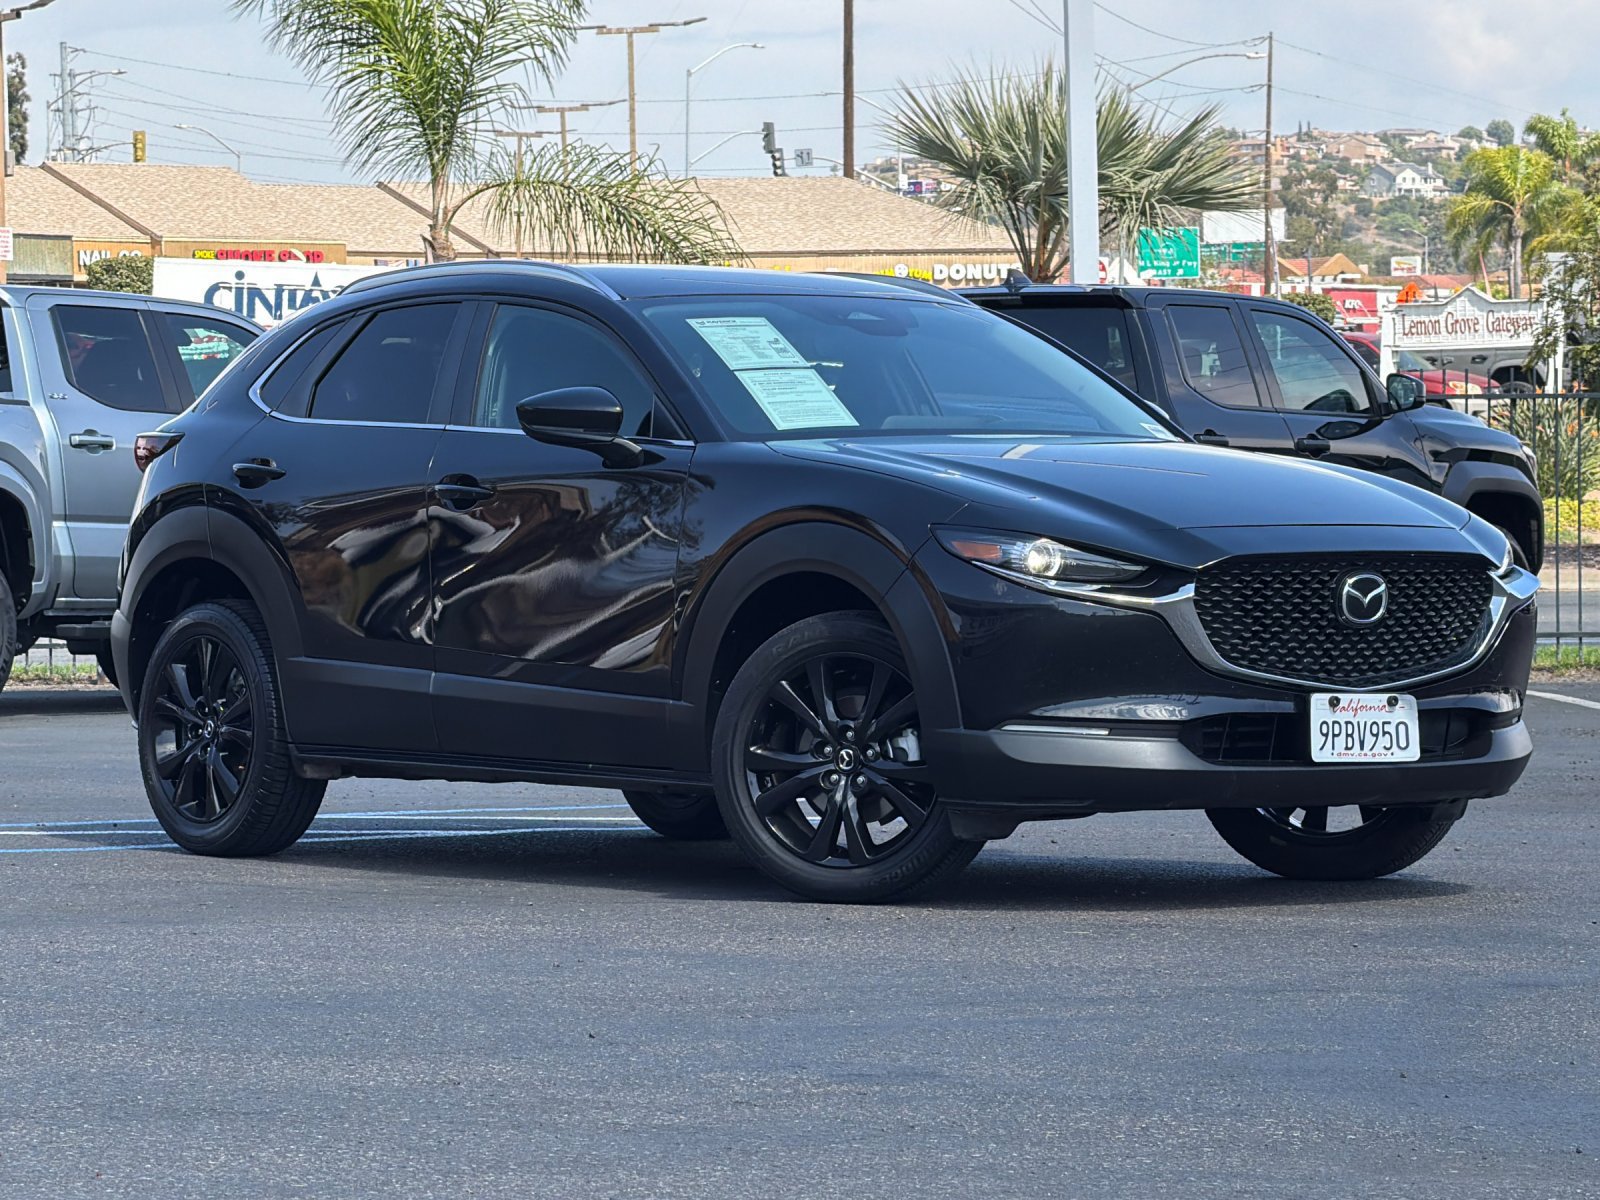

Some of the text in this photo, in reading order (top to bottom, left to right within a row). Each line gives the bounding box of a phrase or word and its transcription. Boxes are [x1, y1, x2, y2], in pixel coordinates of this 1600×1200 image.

[1344, 299, 1361, 309] KFC
[1401, 313, 1441, 337] Lemon
[1445, 311, 1480, 335] Grove
[1318, 720, 1410, 752] 9PBV950
